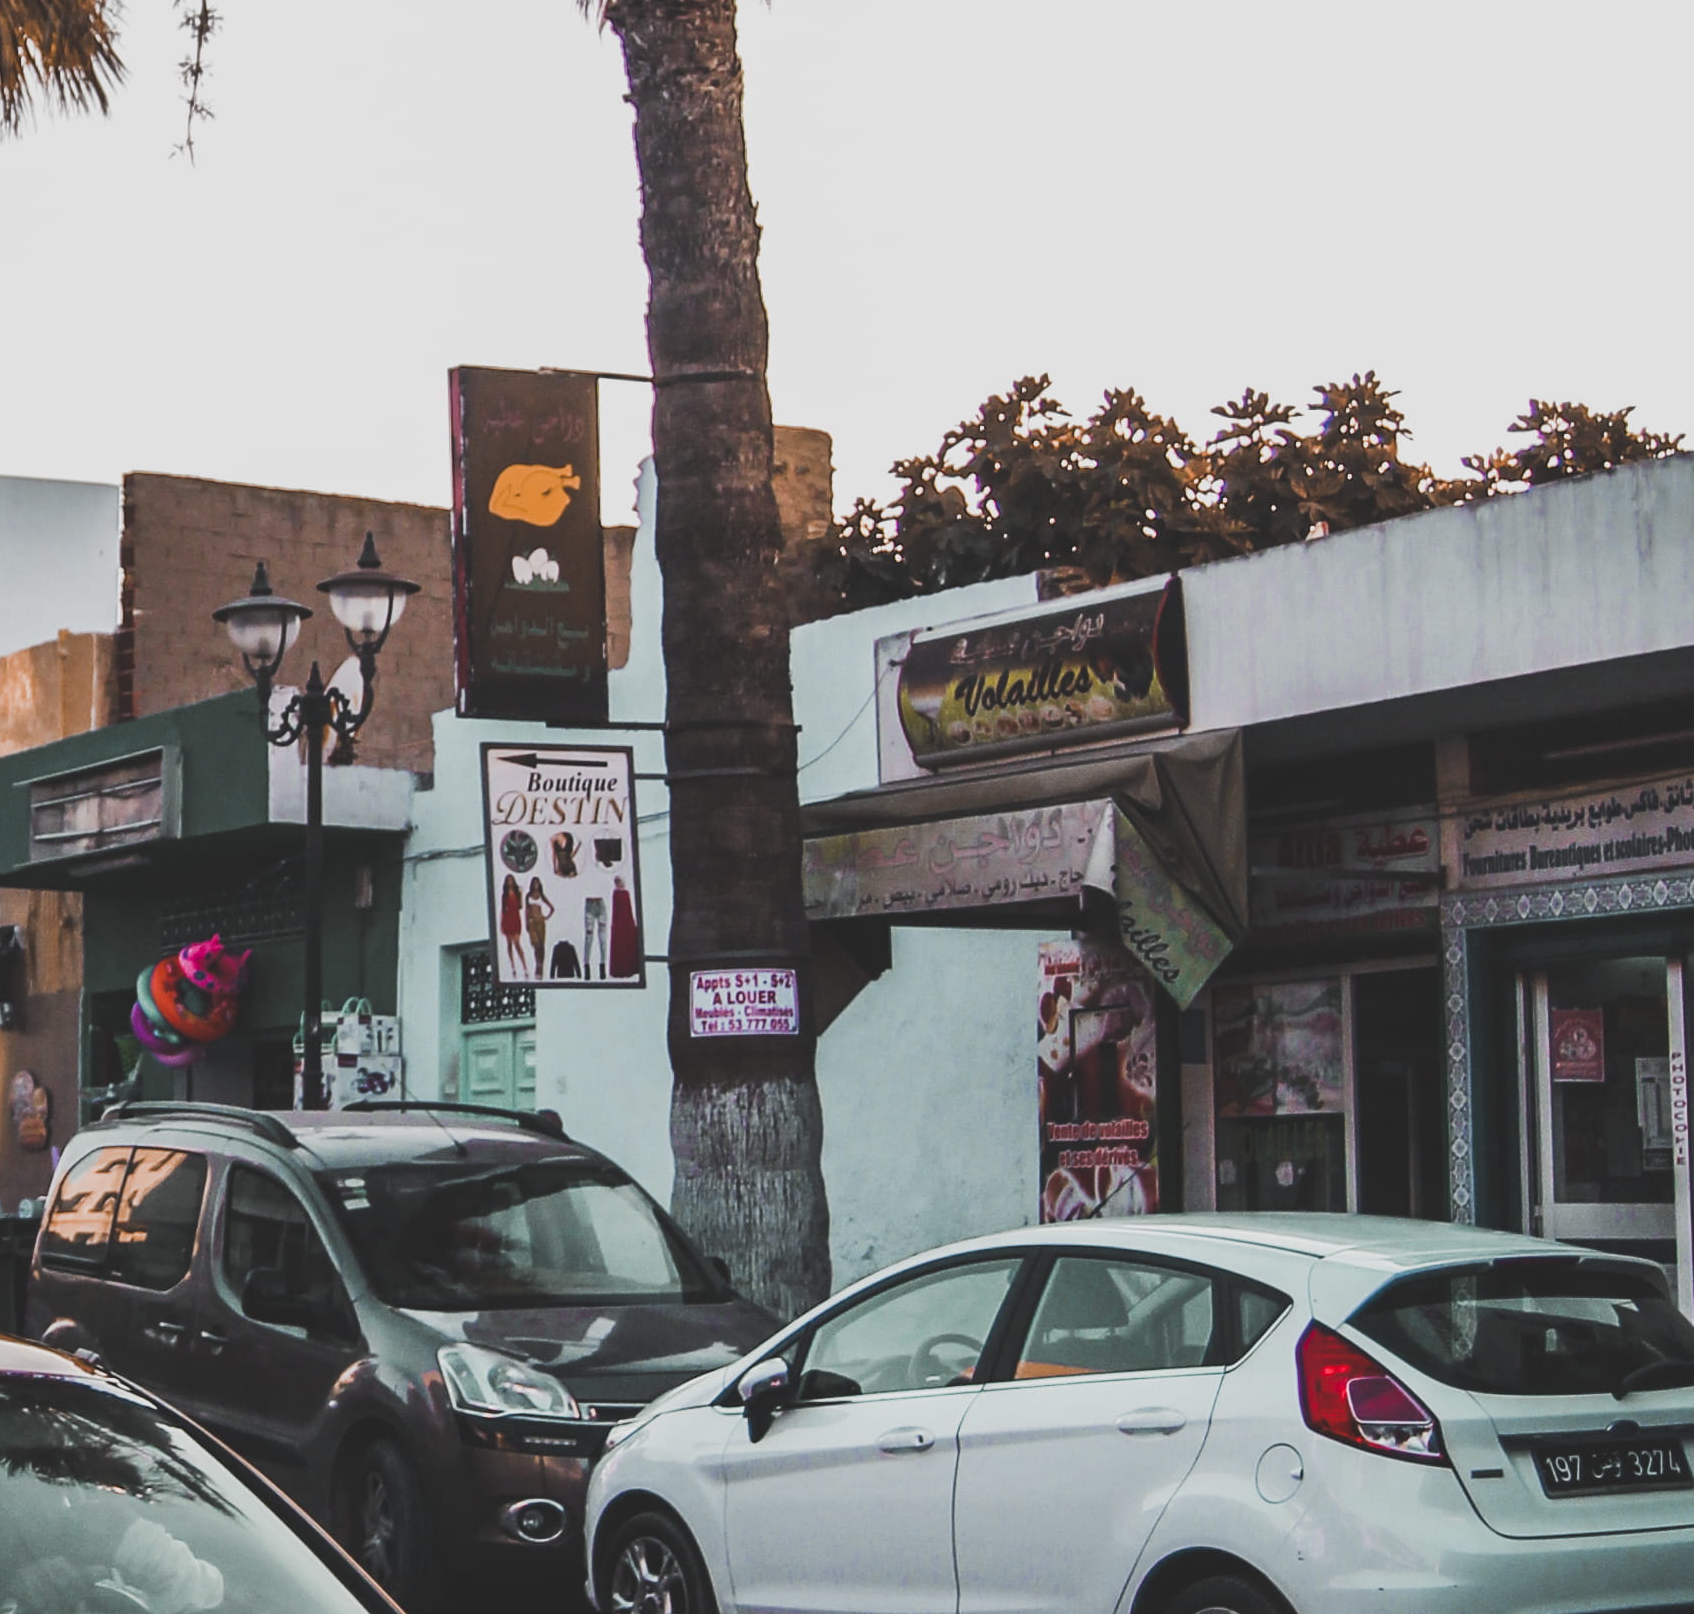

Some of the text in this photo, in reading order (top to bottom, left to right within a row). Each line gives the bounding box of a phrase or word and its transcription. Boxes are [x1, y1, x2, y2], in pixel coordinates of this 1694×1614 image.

[954, 658, 1094, 717] Volailles
[527, 772, 618, 802] Boutique
[1663, 778, 1694, 814] ثائق
[491, 790, 628, 826] DESTIN
[697, 976, 731, 993] Appts
[736, 974, 758, 988] S+1
[713, 991, 777, 1006] A LOUER
[747, 1019, 767, 1030] 777
[1671, 1052, 1689, 1166] PHOTOCOPIE
[1047, 1122, 1082, 1142] Vente
[1083, 1121, 1097, 1139] de
[1546, 1454, 1581, 1483] 197
[1627, 1449, 1681, 1477] 3274
